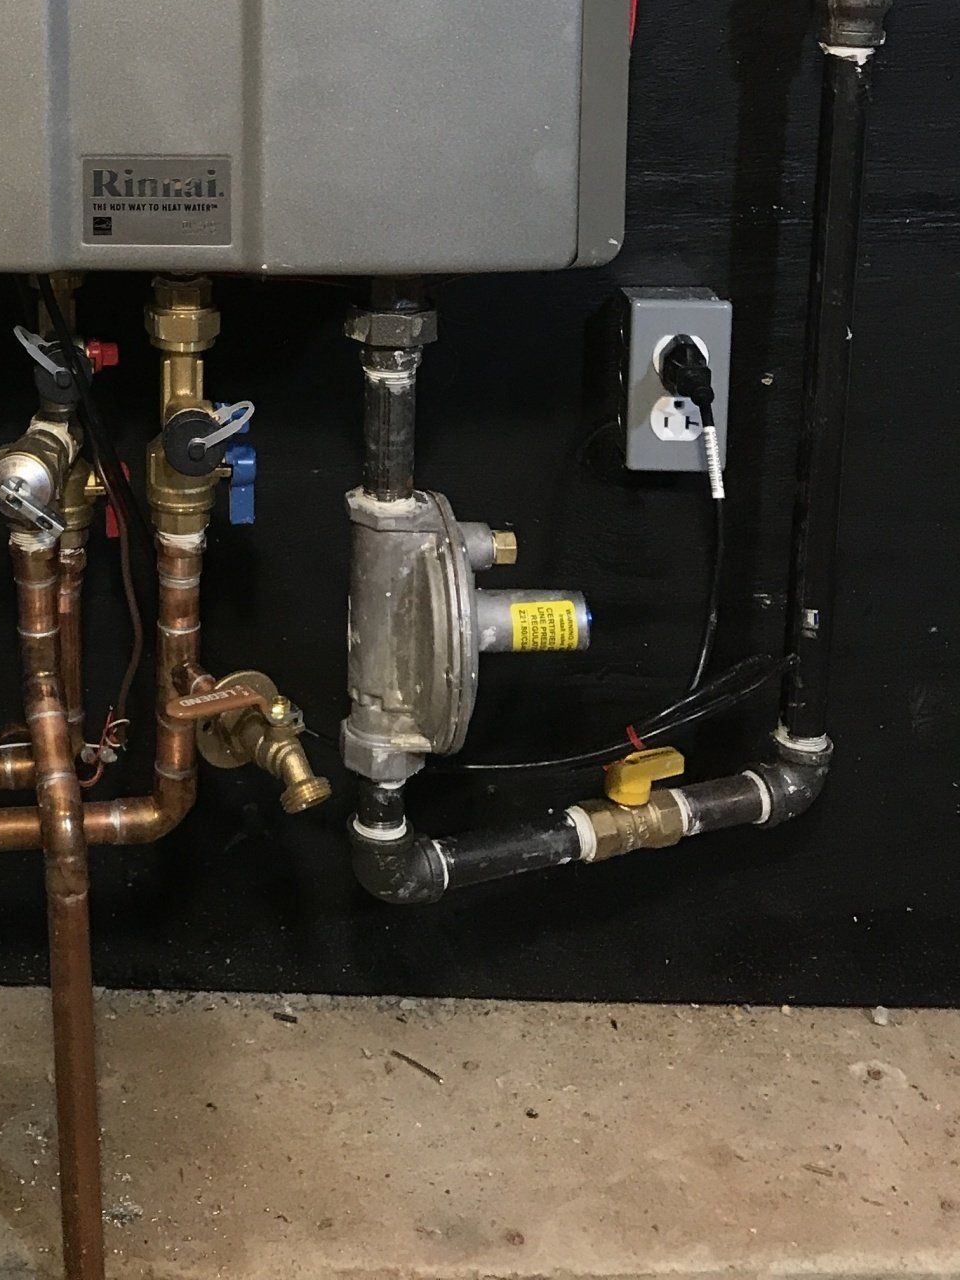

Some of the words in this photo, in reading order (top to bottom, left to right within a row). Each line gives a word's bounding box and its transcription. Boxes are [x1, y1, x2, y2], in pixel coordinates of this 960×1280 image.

[93, 203, 107, 211] THE
[110, 203, 126, 211] HOT
[128, 203, 147, 211] WAY
[149, 203, 159, 211] TO
[162, 203, 182, 212] HEAT
[537, 606, 547, 624] LINE
